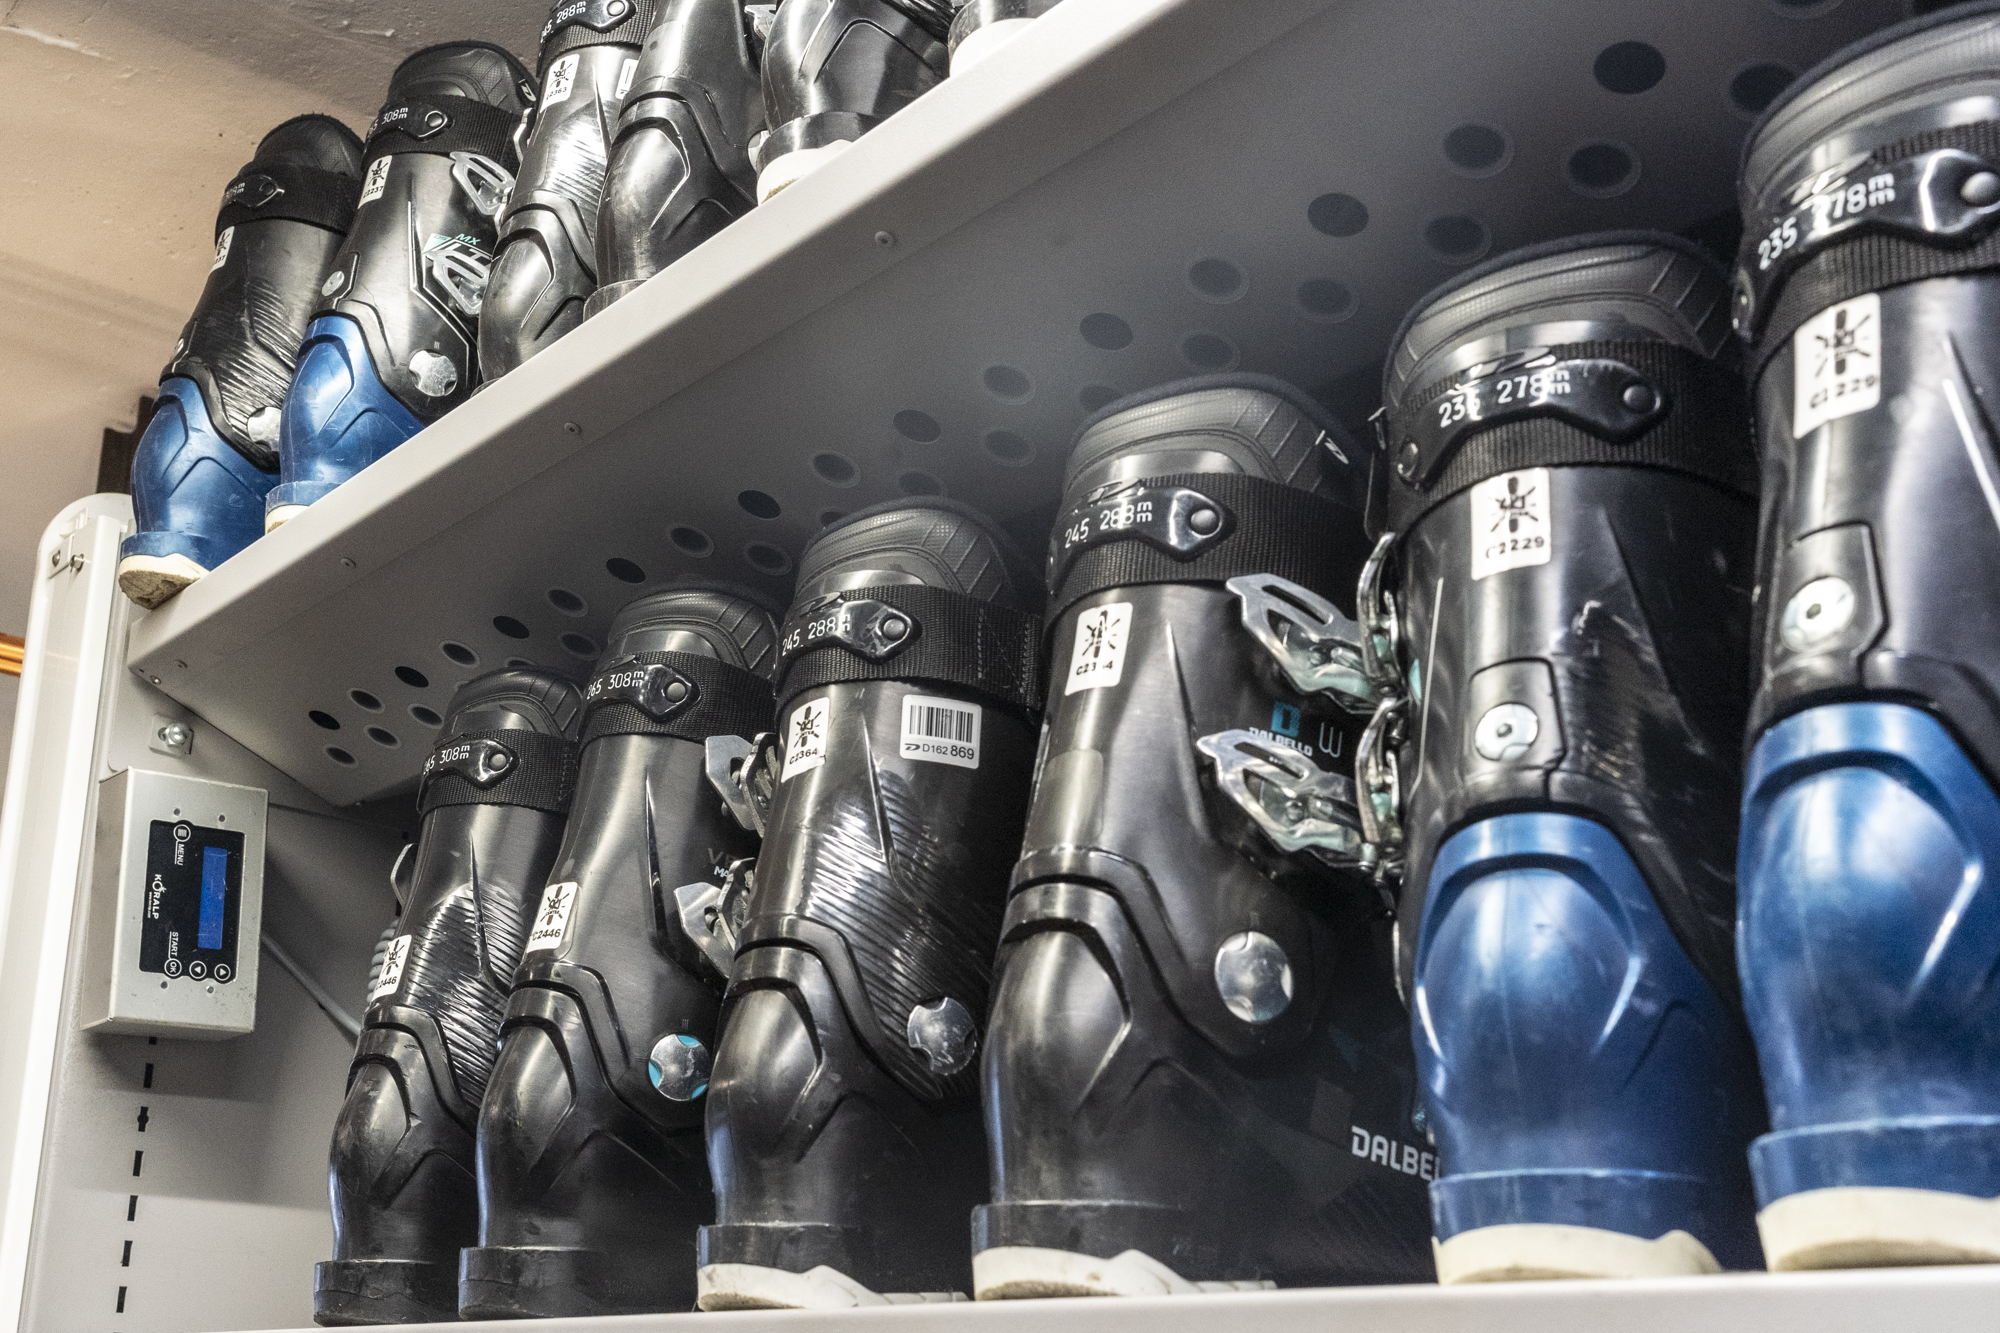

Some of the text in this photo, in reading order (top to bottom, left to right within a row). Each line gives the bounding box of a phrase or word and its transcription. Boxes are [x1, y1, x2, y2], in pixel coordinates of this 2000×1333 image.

[454, 233, 481, 246] MX
[1064, 517, 1090, 549] 245
[781, 628, 801, 657] 245
[1076, 660, 1114, 676] C234
[950, 744, 976, 760] 869
[177, 843, 185, 866] MENU
[152, 873, 167, 920] KORALP
[169, 931, 179, 973] START OK
